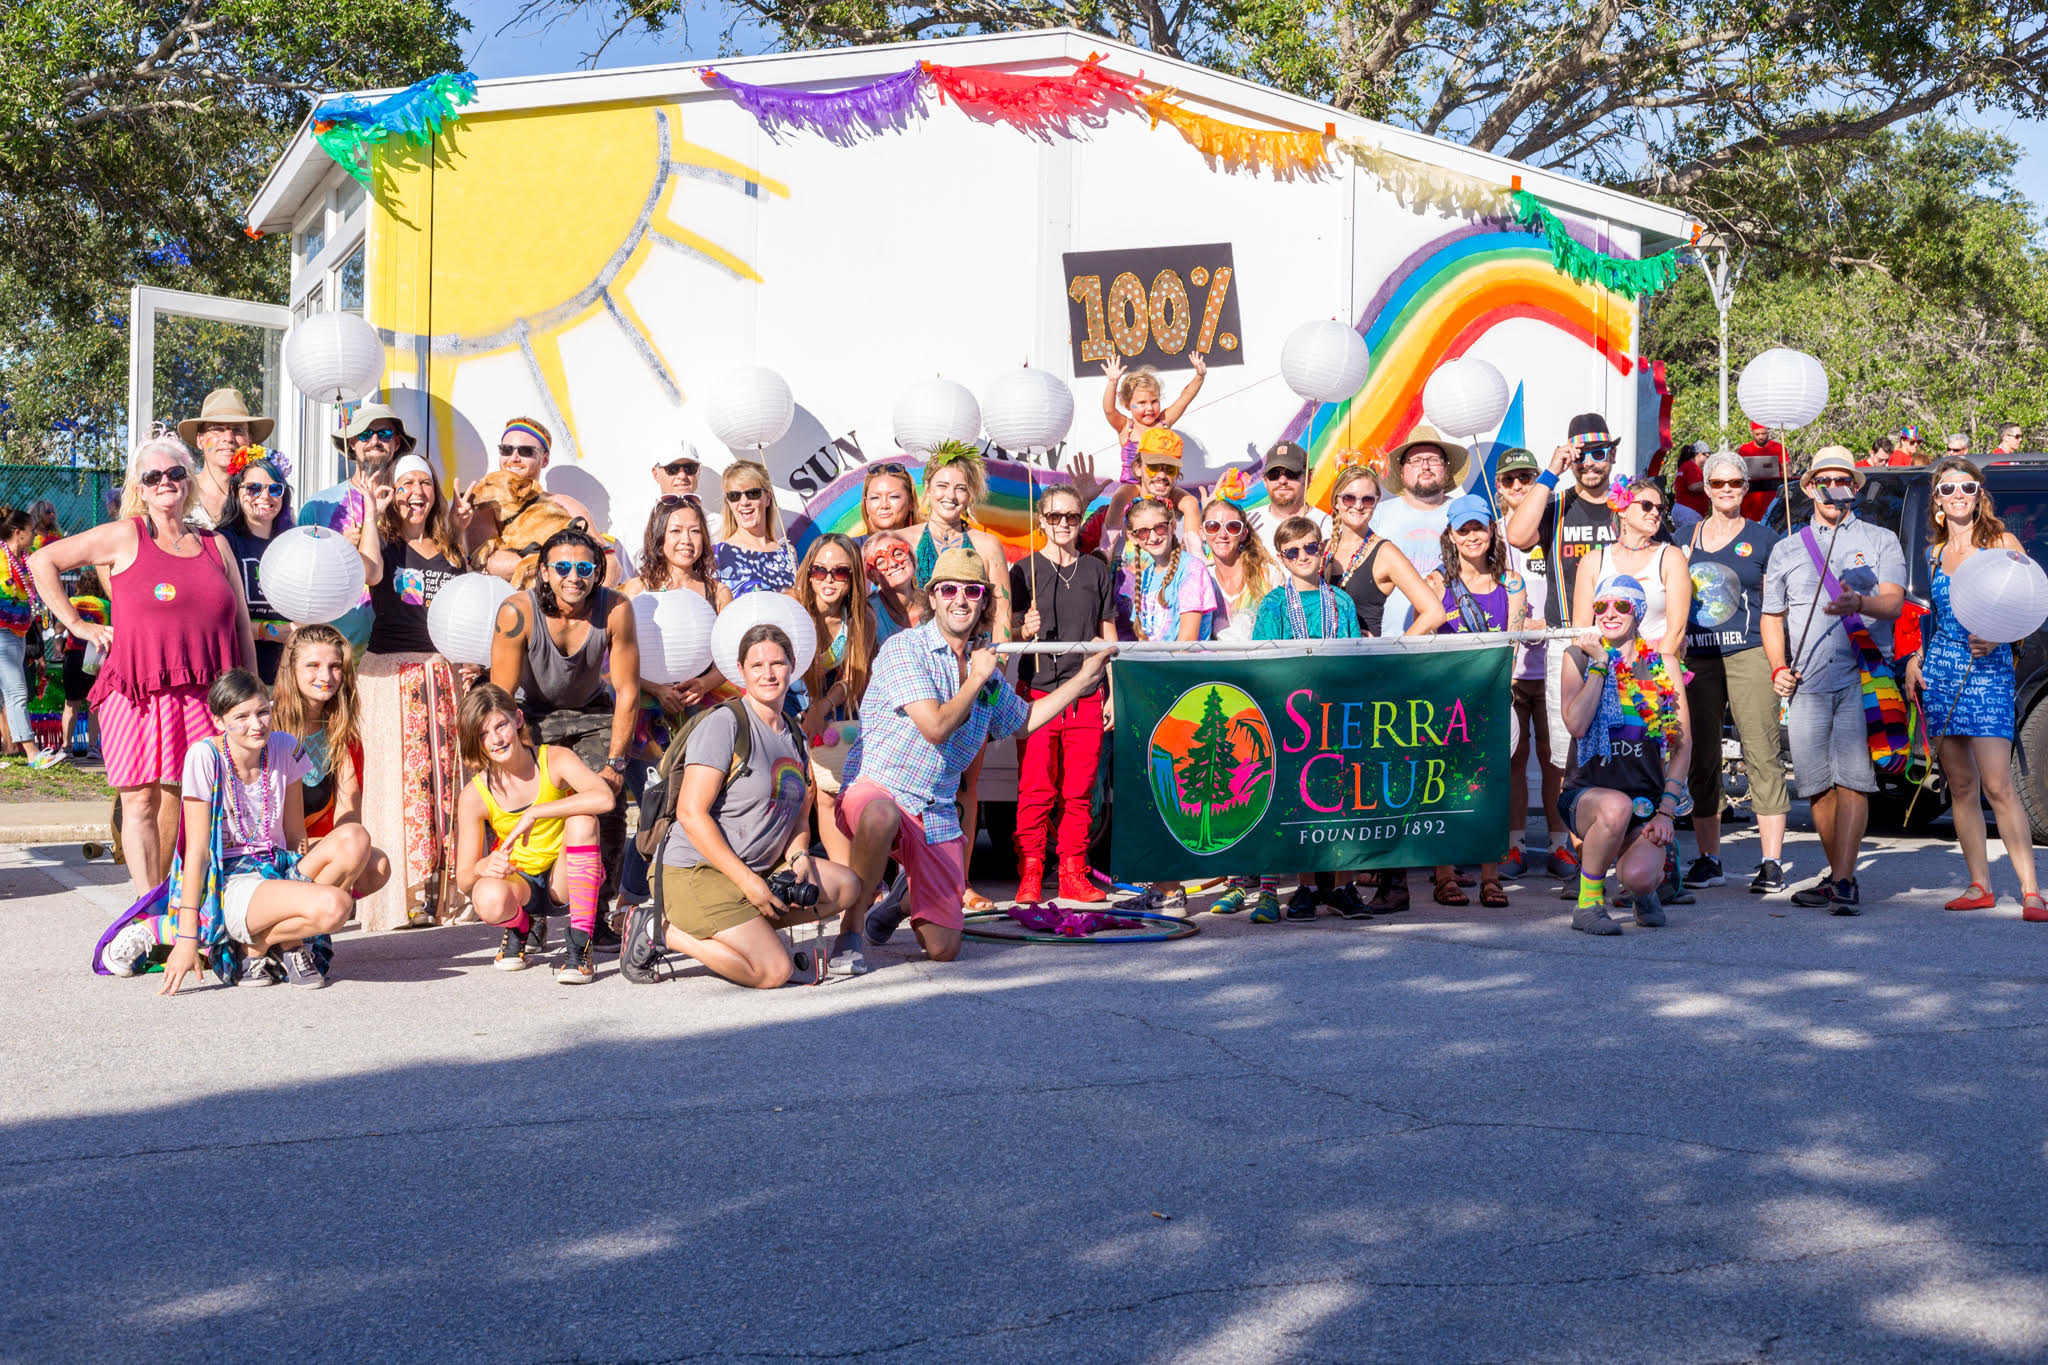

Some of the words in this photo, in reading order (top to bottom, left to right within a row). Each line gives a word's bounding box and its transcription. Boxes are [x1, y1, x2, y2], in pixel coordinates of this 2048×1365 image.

[1069, 266, 1238, 362] 100%
[789, 430, 868, 500] SUN
[1563, 525, 1593, 541] WE
[425, 570, 441, 578] Gay
[1695, 632, 1720, 647] WITH
[1723, 631, 1747, 645] HER.
[1938, 659, 1952, 669] am
[1283, 688, 1472, 753] SIERRA
[1612, 740, 1643, 758] IDE
[1300, 753, 1446, 813] CLUB
[1300, 824, 1397, 845] FOUNDED
[1403, 819, 1446, 837] 1892
